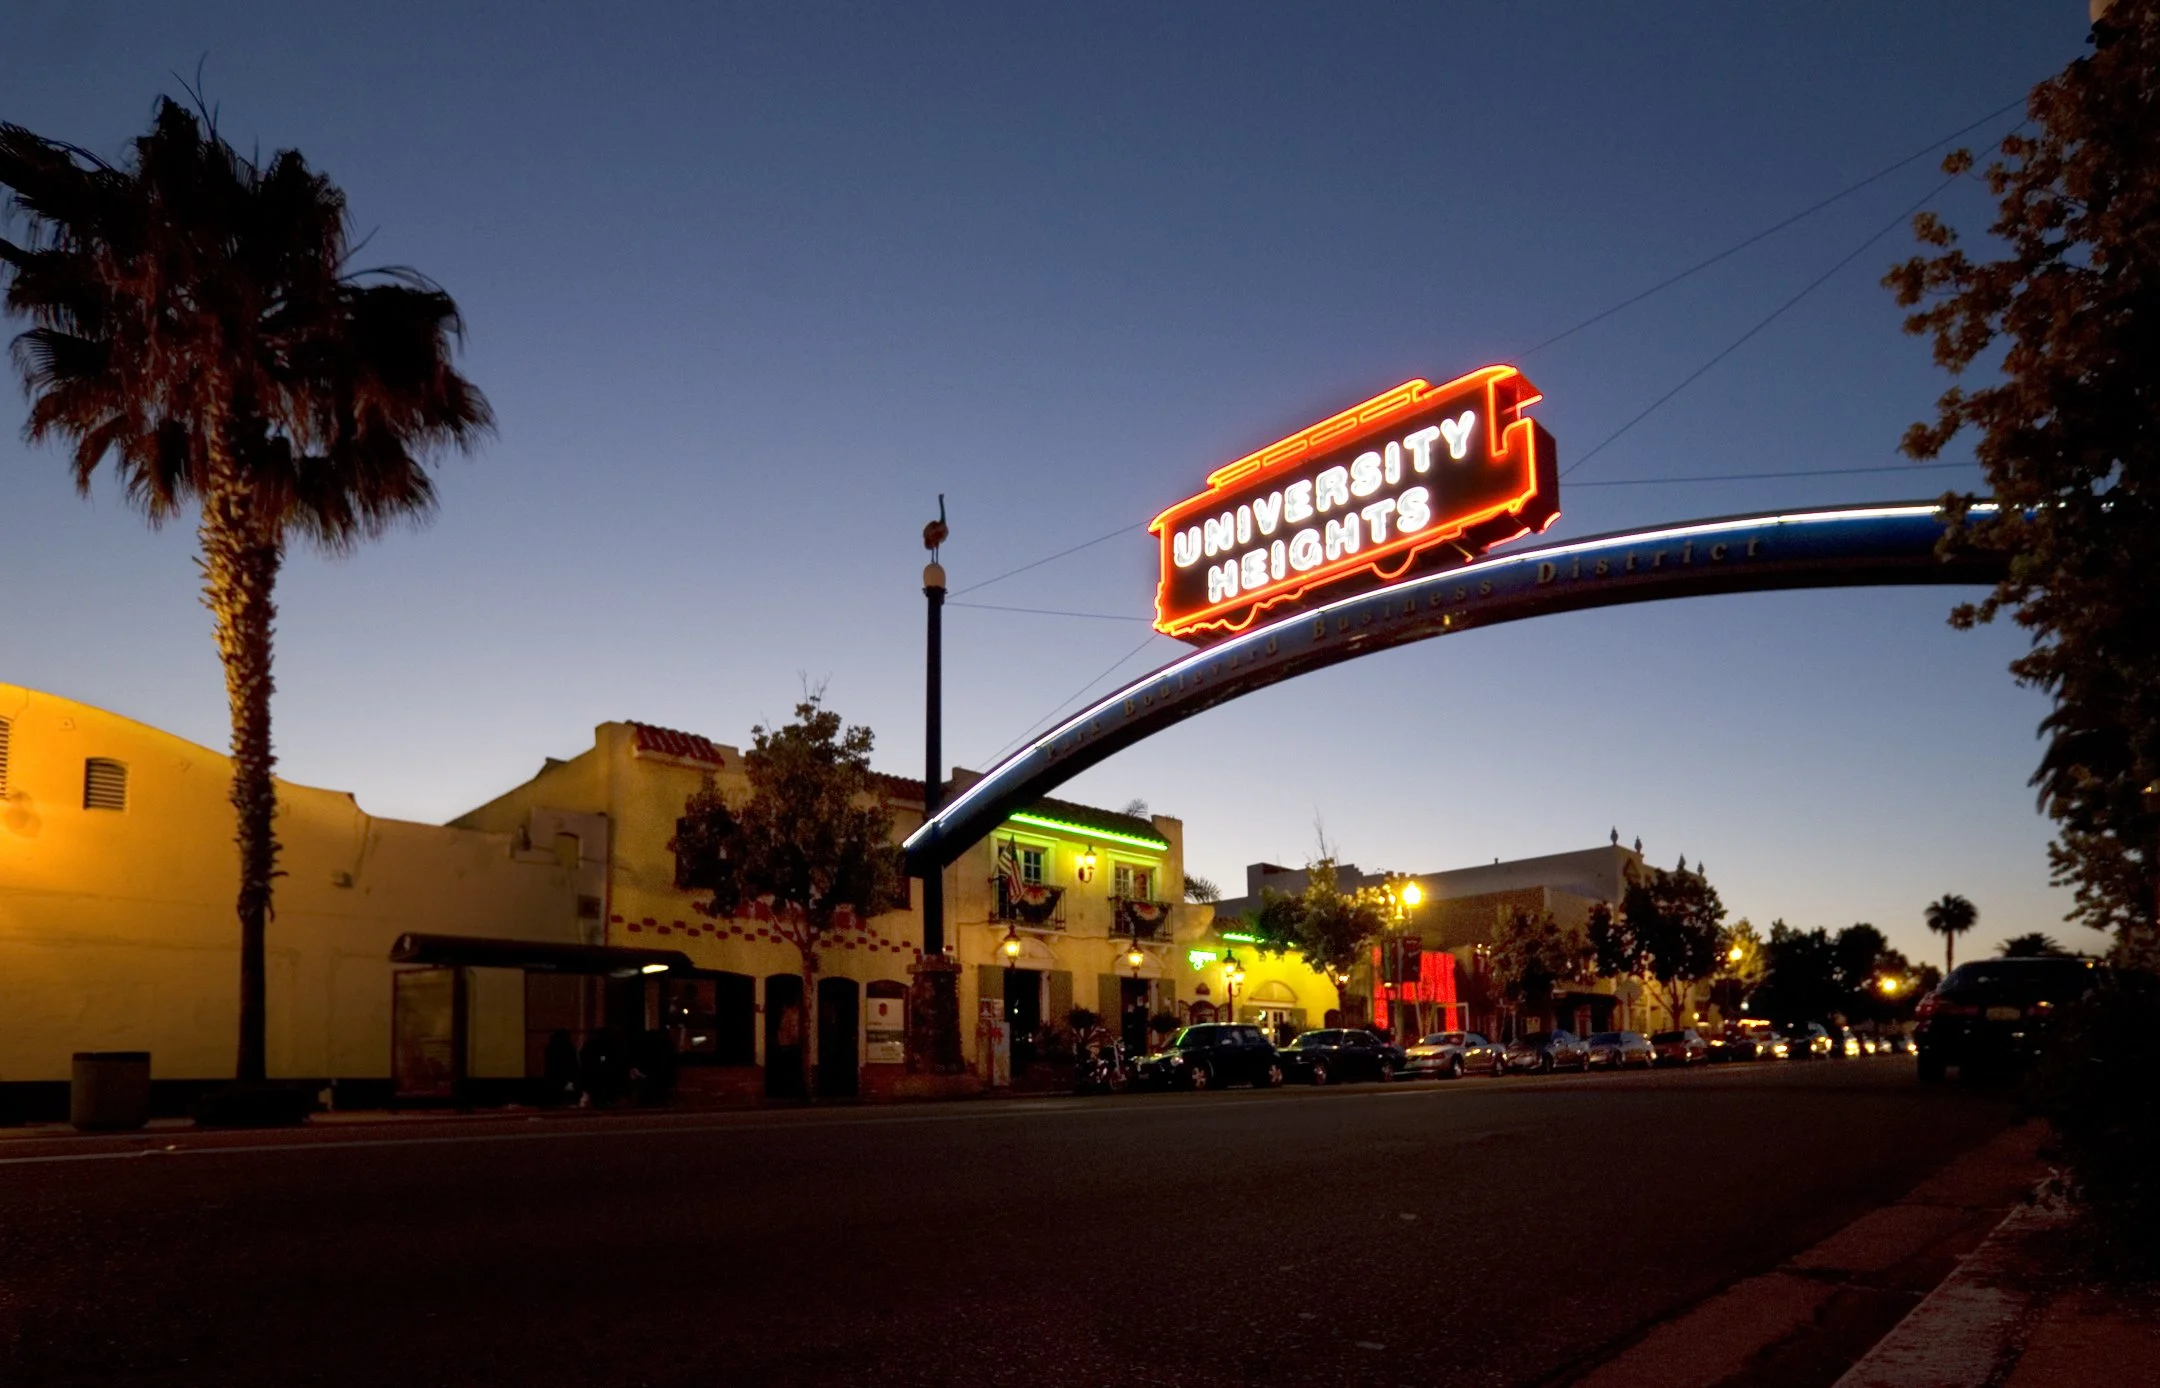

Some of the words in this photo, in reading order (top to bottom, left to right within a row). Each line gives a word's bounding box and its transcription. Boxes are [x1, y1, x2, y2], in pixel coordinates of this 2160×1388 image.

[1172, 409, 1477, 569] UNIVERSITY
[1206, 485, 1432, 604] HEIGHTS
[1123, 636, 1278, 716] Boulevard
[1313, 579, 1493, 641] Business
[1536, 536, 1761, 585] District
